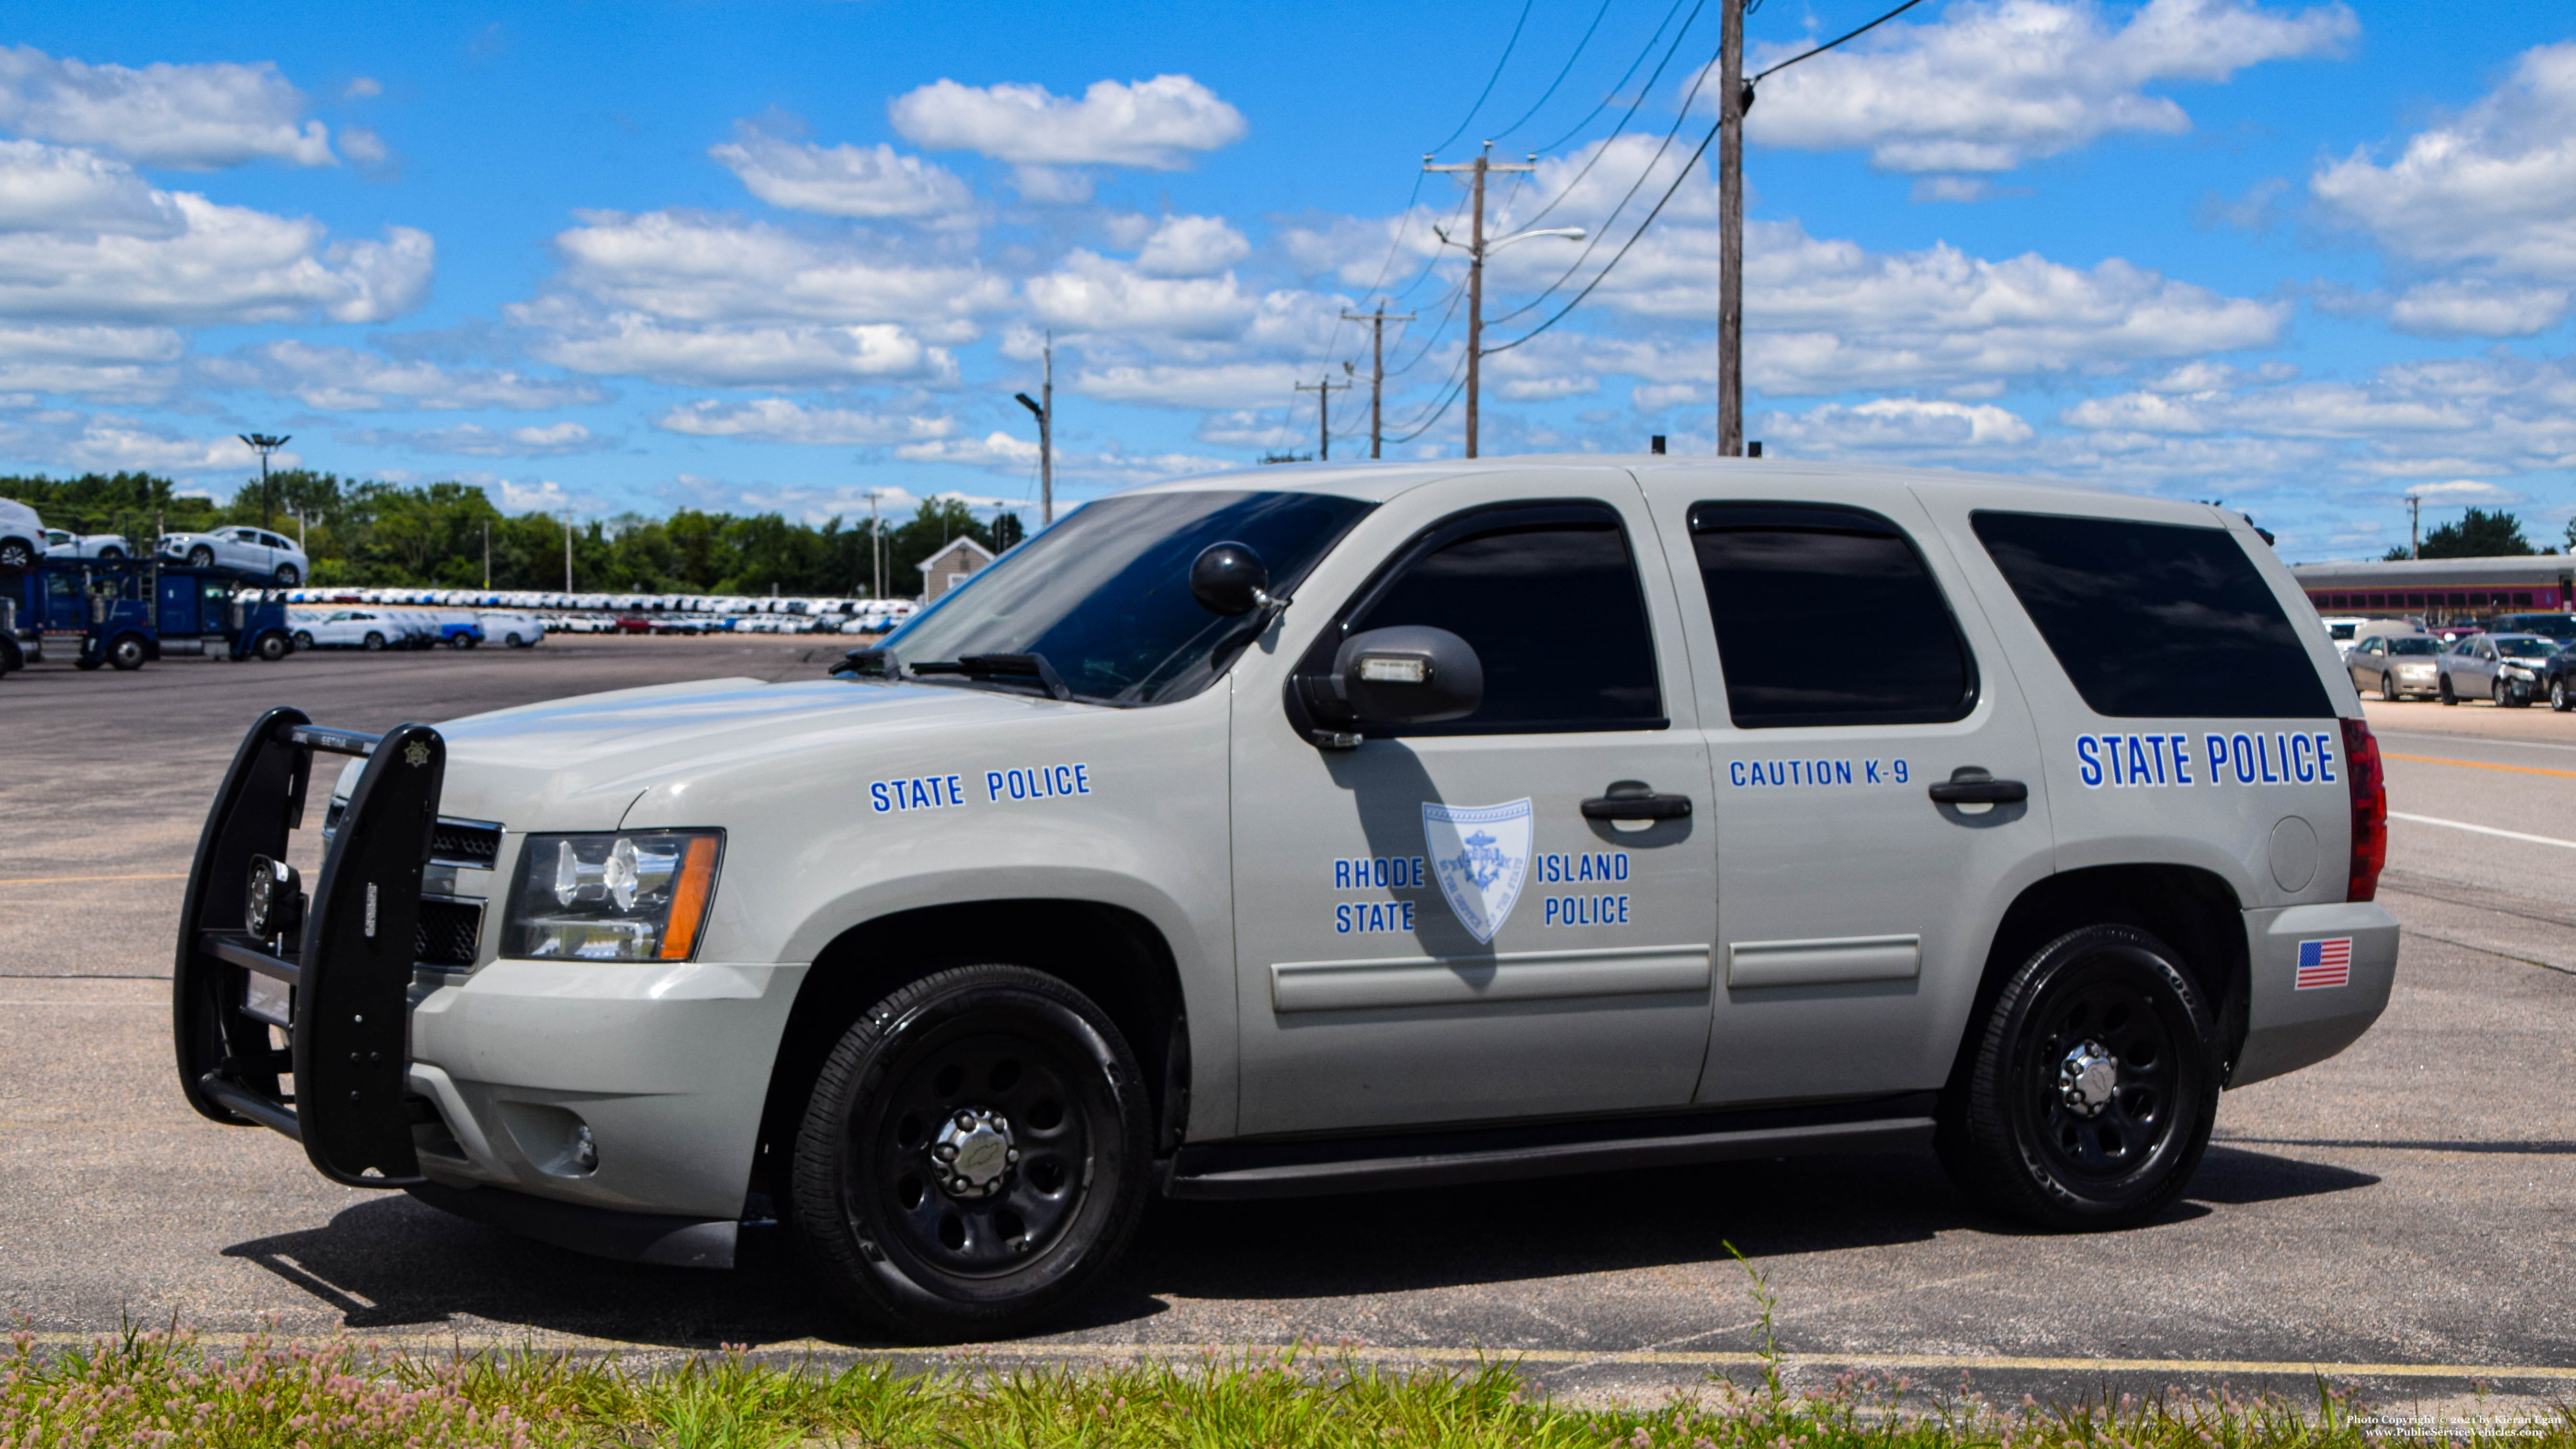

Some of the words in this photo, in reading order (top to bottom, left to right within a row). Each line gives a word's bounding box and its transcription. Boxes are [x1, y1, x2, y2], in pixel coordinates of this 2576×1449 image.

[1729, 759, 1852, 787] CAUTION
[1865, 758, 1909, 785] K-9
[2077, 733, 2194, 789] STATE
[2204, 732, 2336, 786] POLICE
[870, 773, 965, 814] STATE
[985, 763, 1091, 803] POLICE
[1334, 856, 1425, 889] RHODE
[1536, 851, 1629, 885] ISLAND
[1335, 901, 1414, 934] STATE
[1545, 894, 1630, 927] POLICE
